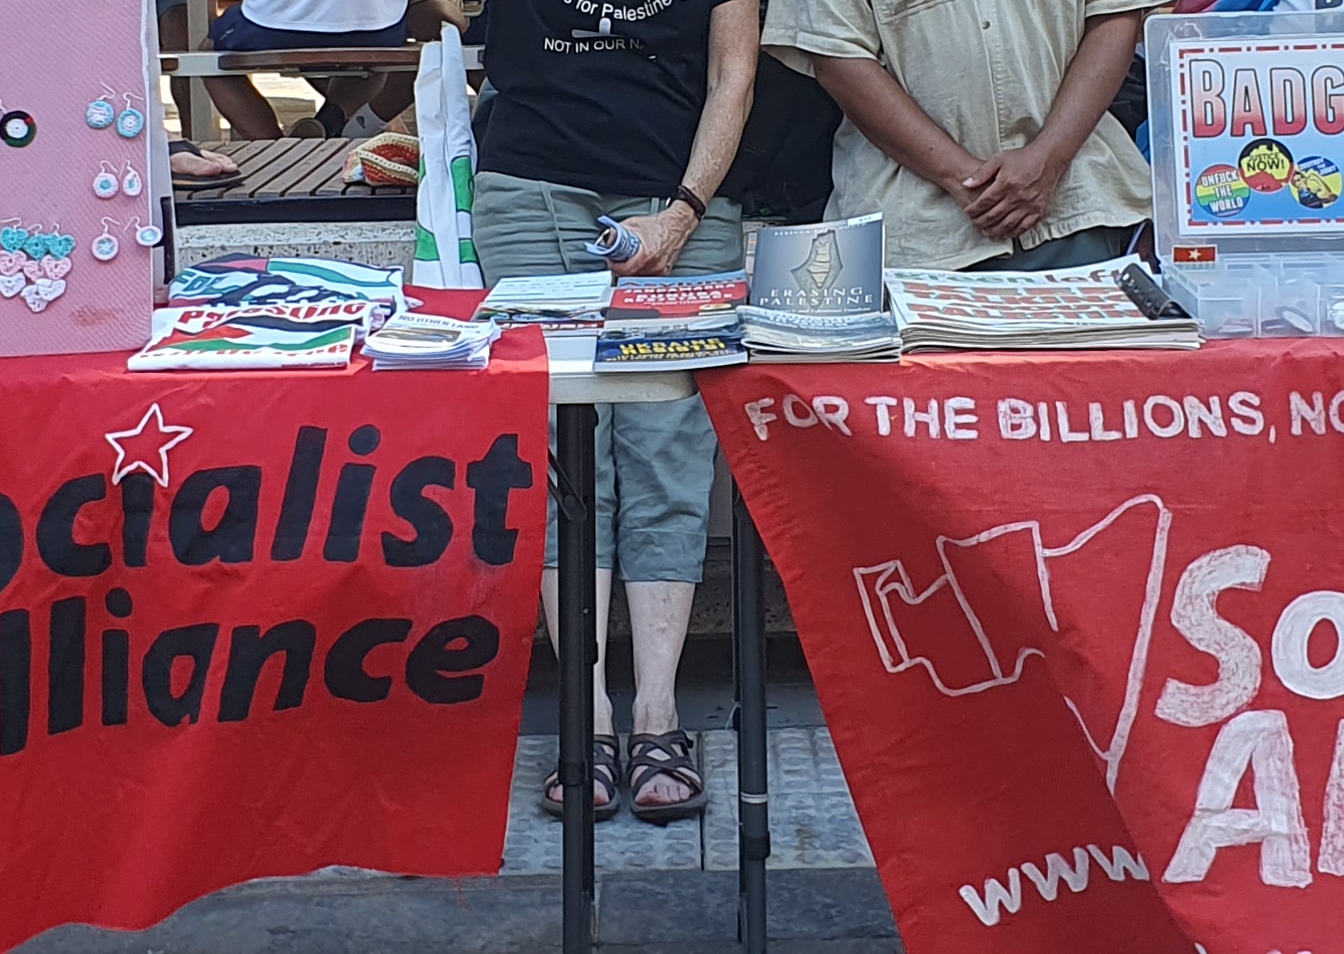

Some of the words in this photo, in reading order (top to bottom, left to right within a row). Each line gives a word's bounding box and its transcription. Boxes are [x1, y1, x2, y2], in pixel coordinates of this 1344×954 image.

[544, 38, 572, 54] NOT
[576, 42, 589, 54] IN
[593, 39, 626, 50] OUR
[1247, 152, 1281, 163] JUSTICE
[1246, 158, 1286, 172] NOW!
[1201, 169, 1239, 187] UNFUCK
[1213, 184, 1232, 197] THE
[1208, 199, 1244, 214] WORLD
[770, 286, 863, 298] ERASING
[759, 294, 874, 306] PALESTINE
[745, 395, 852, 444] FOR
[865, 396, 979, 444] THE
[997, 391, 1277, 446] BILLIONS,
